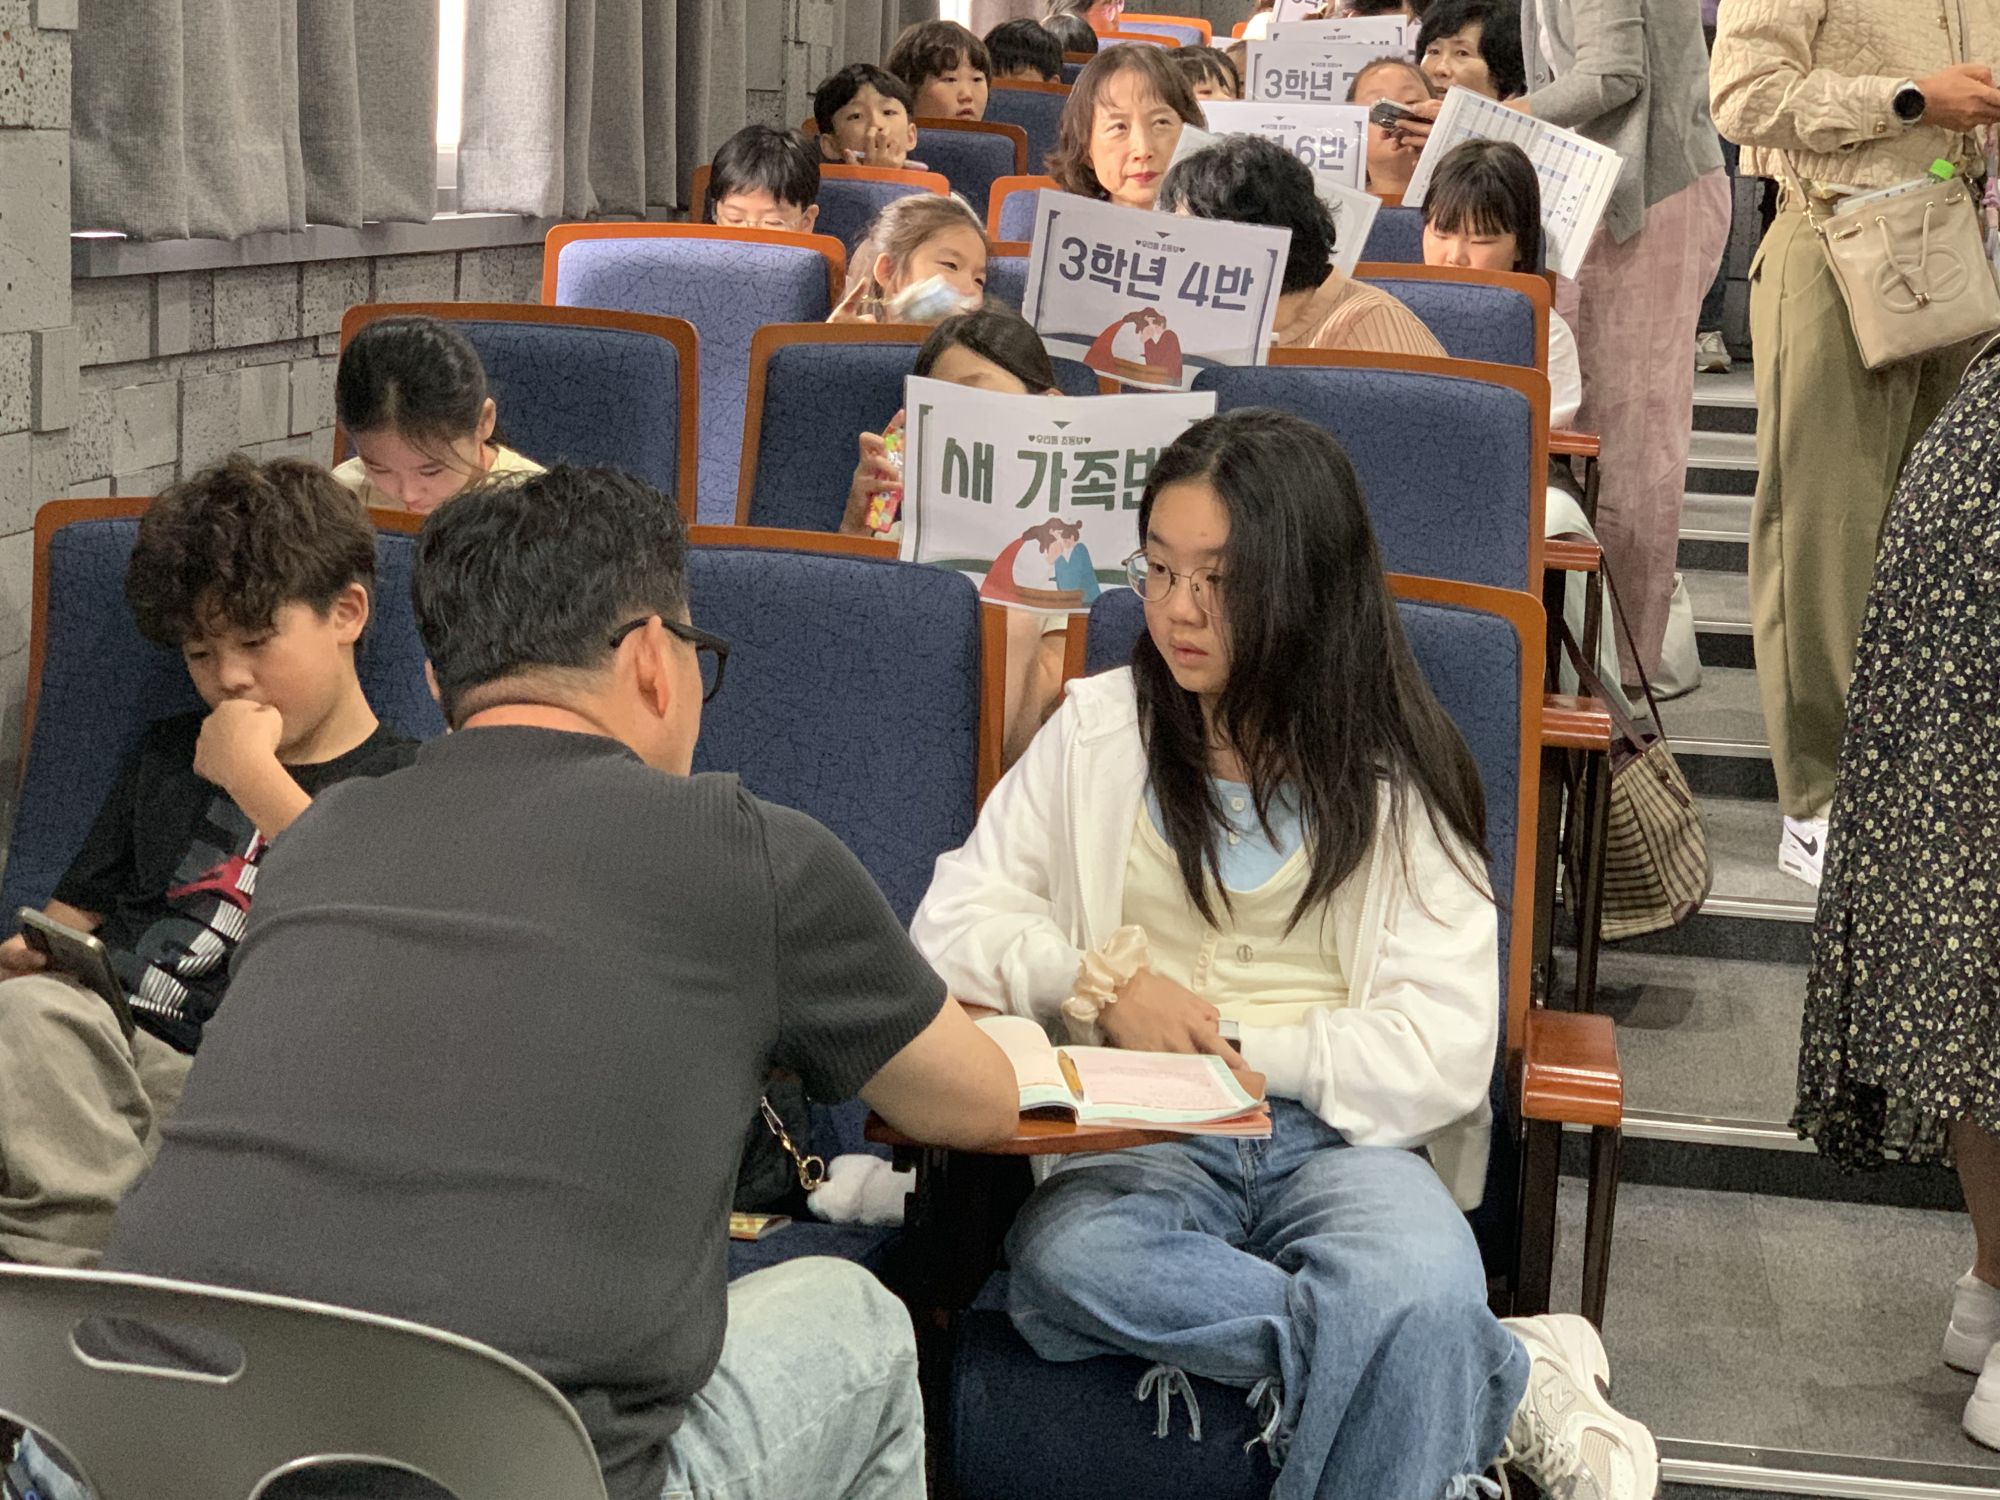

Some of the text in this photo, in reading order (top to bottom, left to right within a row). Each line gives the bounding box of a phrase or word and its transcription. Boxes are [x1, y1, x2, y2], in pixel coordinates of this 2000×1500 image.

[1264, 68, 1333, 102] 3학년
[1295, 135, 1347, 171] 6반
[1059, 236, 1254, 312] 3학년 4반
[941, 437, 994, 504] 새
